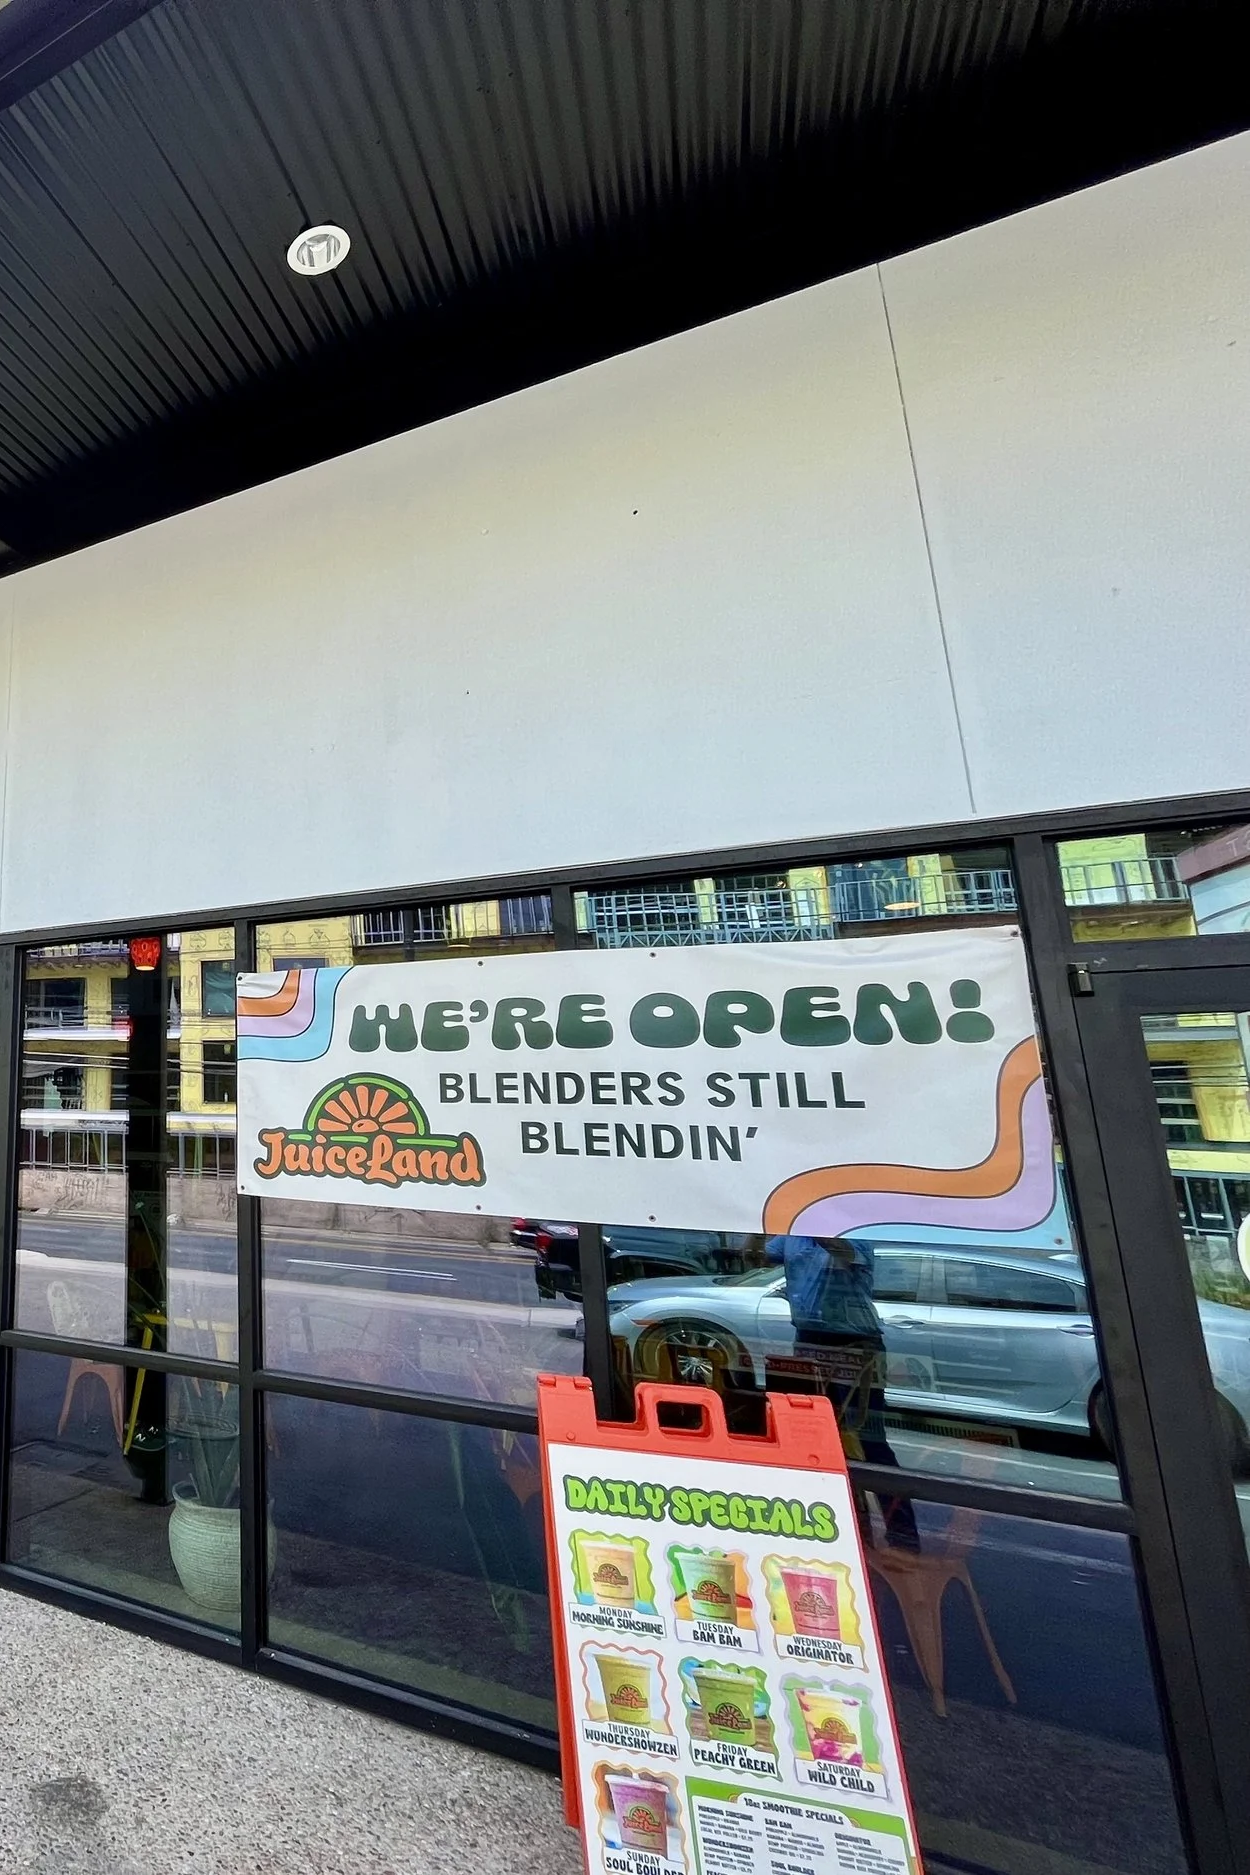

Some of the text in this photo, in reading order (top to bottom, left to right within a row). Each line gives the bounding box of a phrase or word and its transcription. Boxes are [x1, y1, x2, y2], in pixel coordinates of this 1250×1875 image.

[349, 977, 995, 1053] WE'RE OPEN!
[439, 1070, 866, 1110] BLENDERS STILL
[521, 1120, 759, 1162] BLENDIN'
[254, 1126, 488, 1188] JuiceLand
[563, 1474, 840, 1543] DAILY SPECIALS
[572, 1611, 664, 1635] MORNING SUNSHINE
[599, 1606, 633, 1618] MONDAY
[692, 1629, 742, 1648] BAM BAM
[697, 1621, 734, 1635] TUESDAY
[786, 1643, 855, 1666] ORIGINATOR
[793, 1635, 842, 1651] WEDNESDAY
[584, 1728, 678, 1756] WUNDERSHOWZEN
[607, 1723, 651, 1739] THURSDAY
[716, 1742, 748, 1757] FRIDAY
[694, 1749, 776, 1774] PEACHY GREEN
[816, 1761, 861, 1778] SATURDAY
[807, 1769, 875, 1793] WILD CHILD
[762, 1801, 804, 1818] SMOOTHIE
[805, 1809, 844, 1825] SPECIALS
[606, 1856, 634, 1873] SOUL
[626, 1851, 661, 1866] SUNDAY
